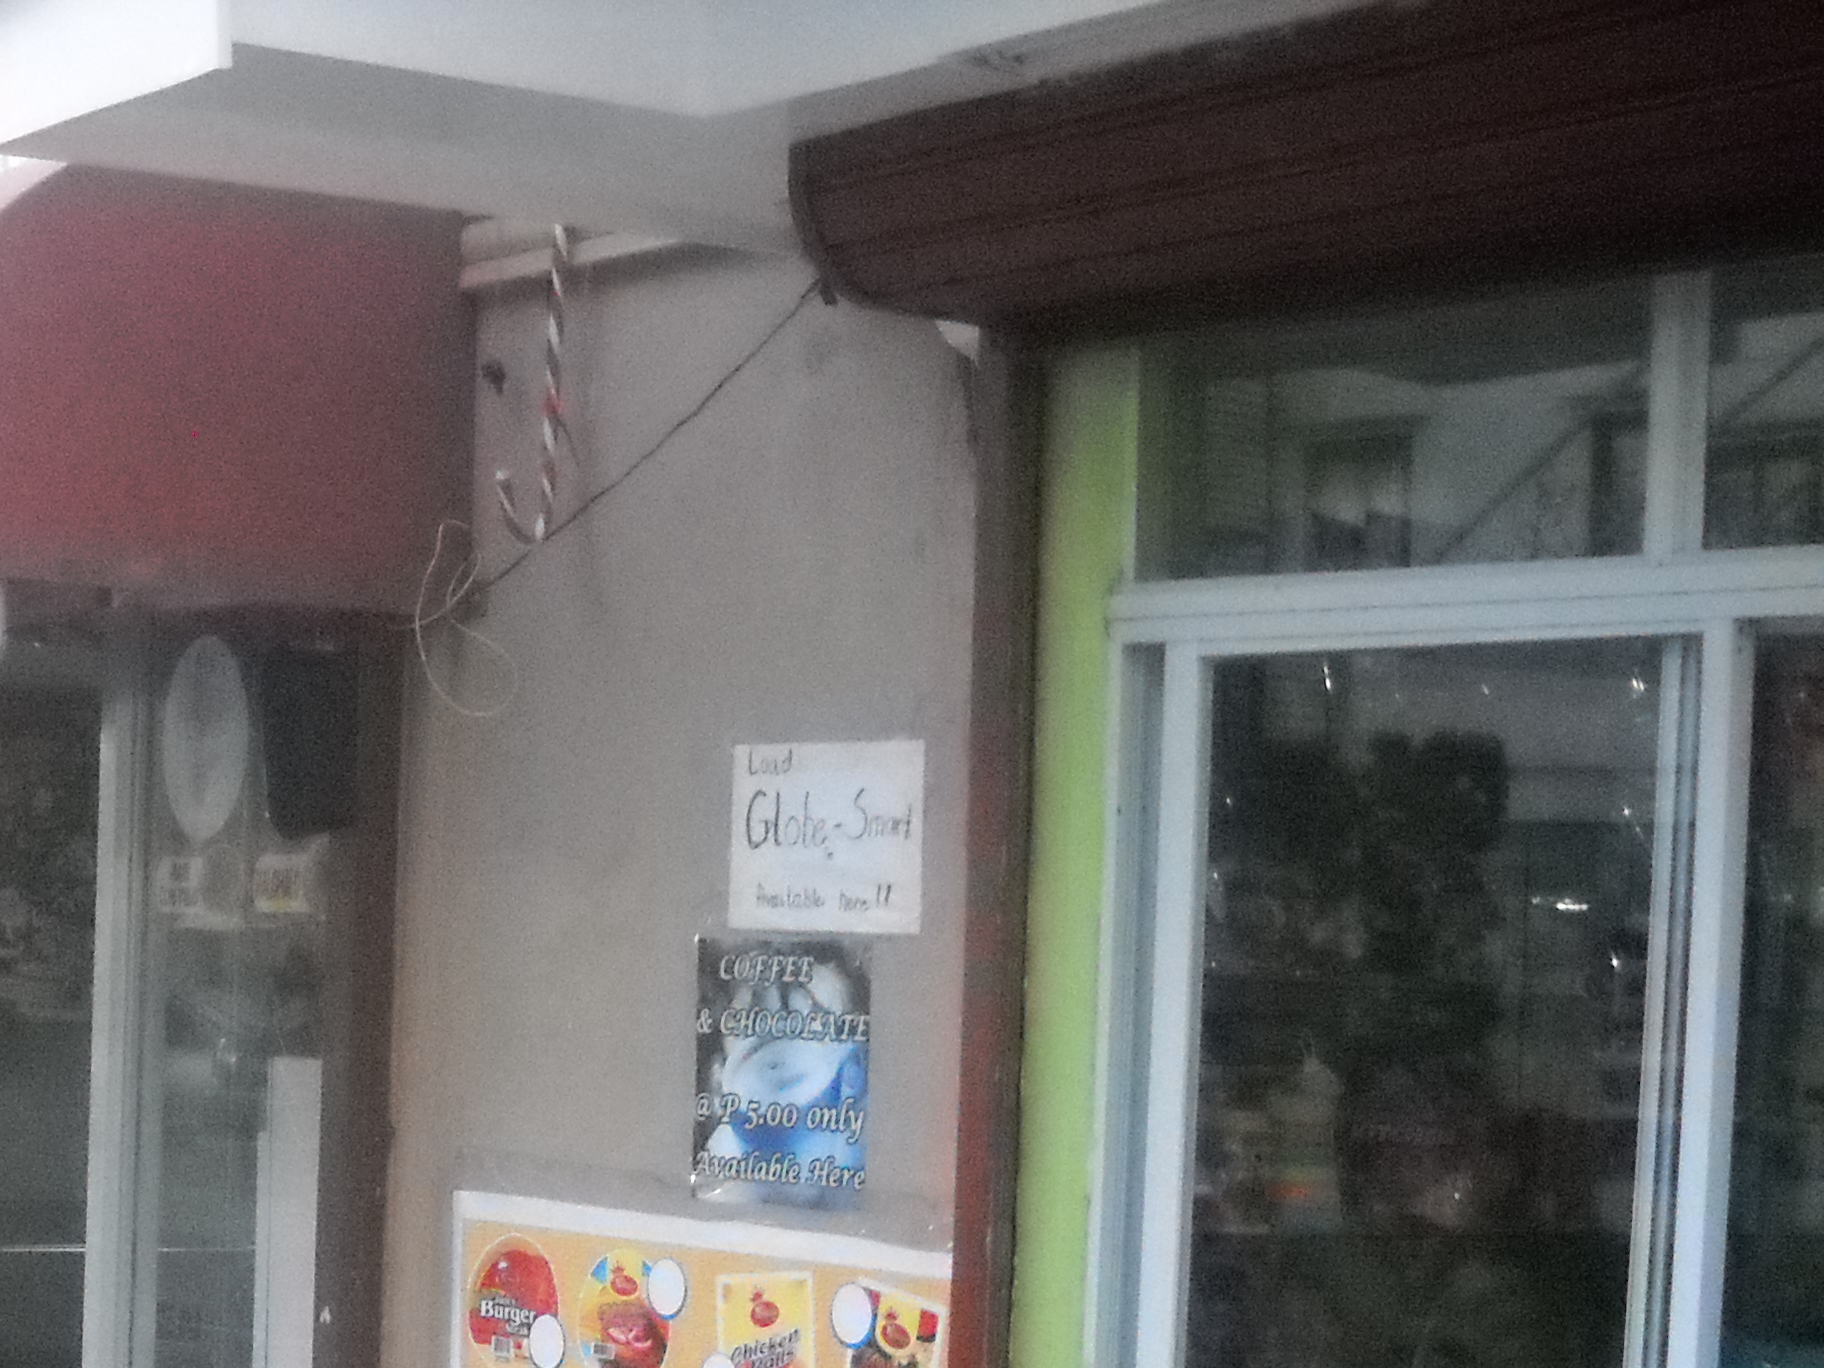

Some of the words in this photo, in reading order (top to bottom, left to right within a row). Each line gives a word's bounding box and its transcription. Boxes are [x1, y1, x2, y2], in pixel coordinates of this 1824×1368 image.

[719, 955, 815, 986] COFFEE
[696, 1007, 713, 1034] &
[719, 1006, 871, 1042] CHOCOLATE
[744, 1099, 798, 1130] 5.00
[806, 1096, 865, 1143] only
[693, 1150, 801, 1184] Available
[807, 1154, 866, 1190] Here
[480, 1299, 536, 1325] Burger
[730, 1327, 800, 1366] Chicken
